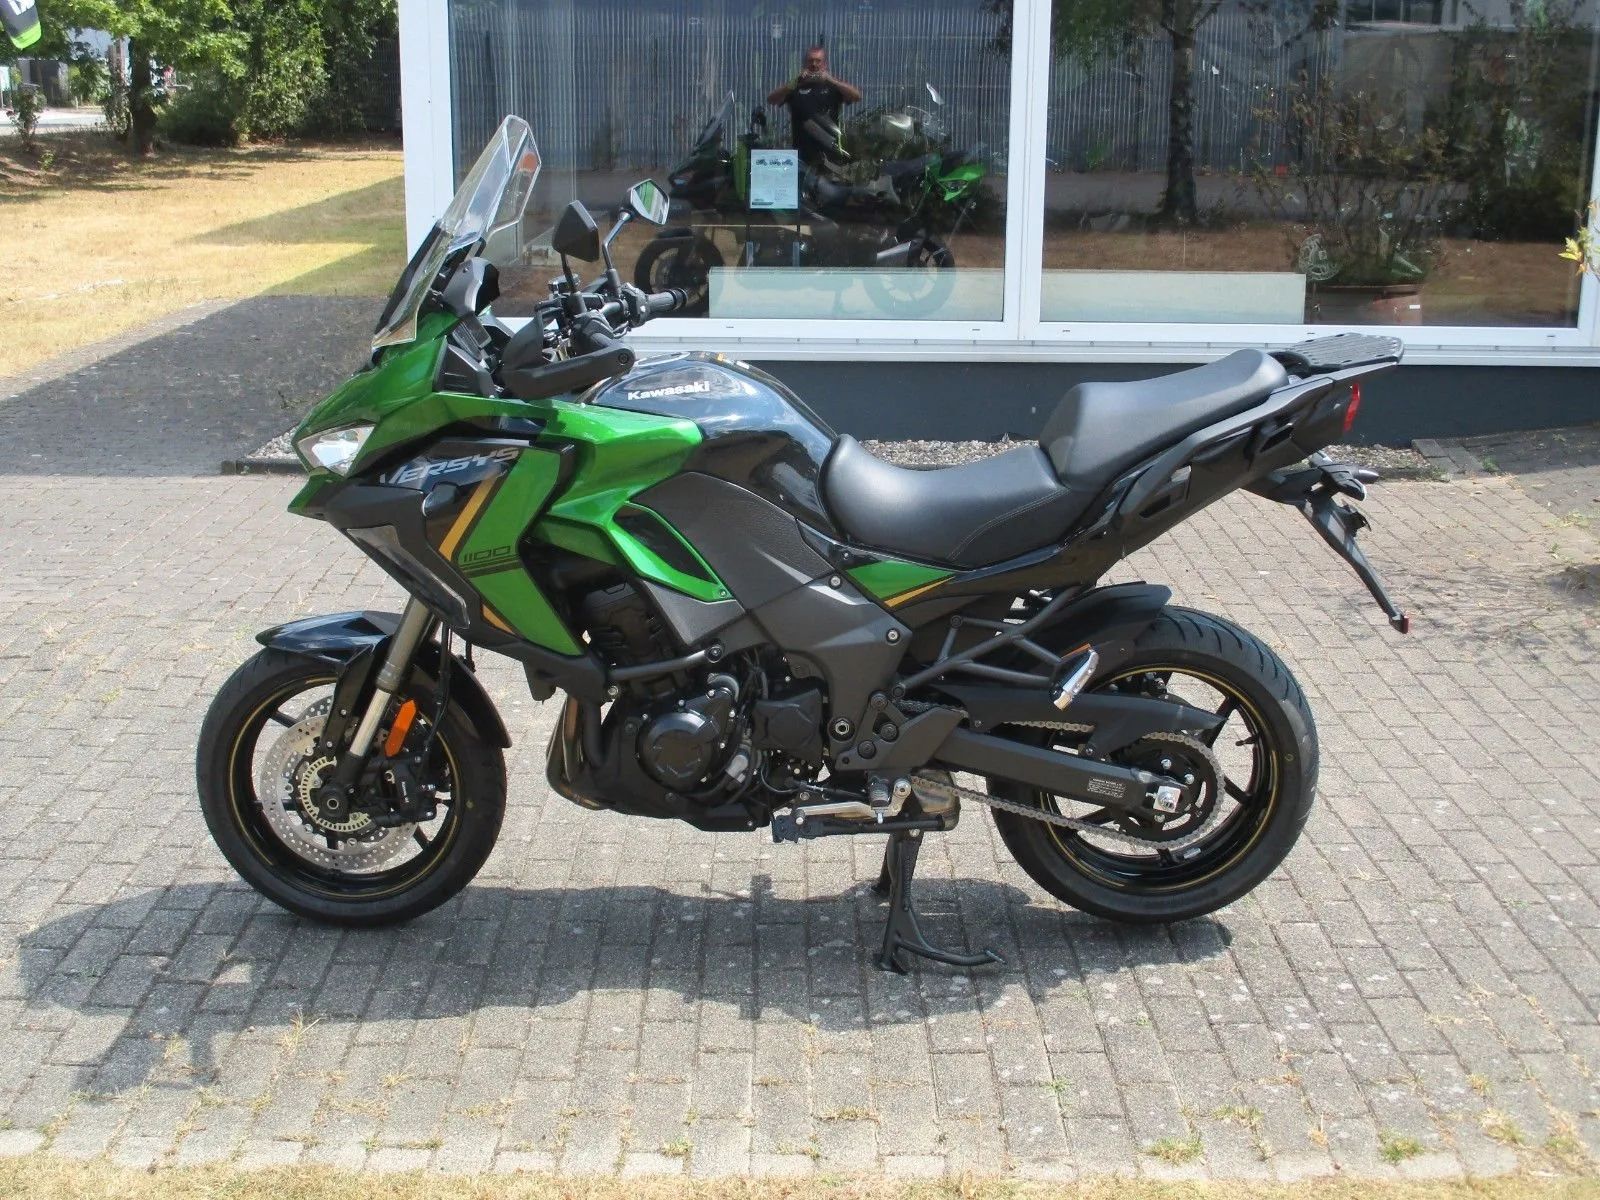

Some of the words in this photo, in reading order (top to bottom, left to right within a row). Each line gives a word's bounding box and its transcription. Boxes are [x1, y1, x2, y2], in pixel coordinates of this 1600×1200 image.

[627, 380, 710, 401] Kawasaki
[379, 446, 519, 485] VERSYS
[463, 545, 511, 563] 1100
